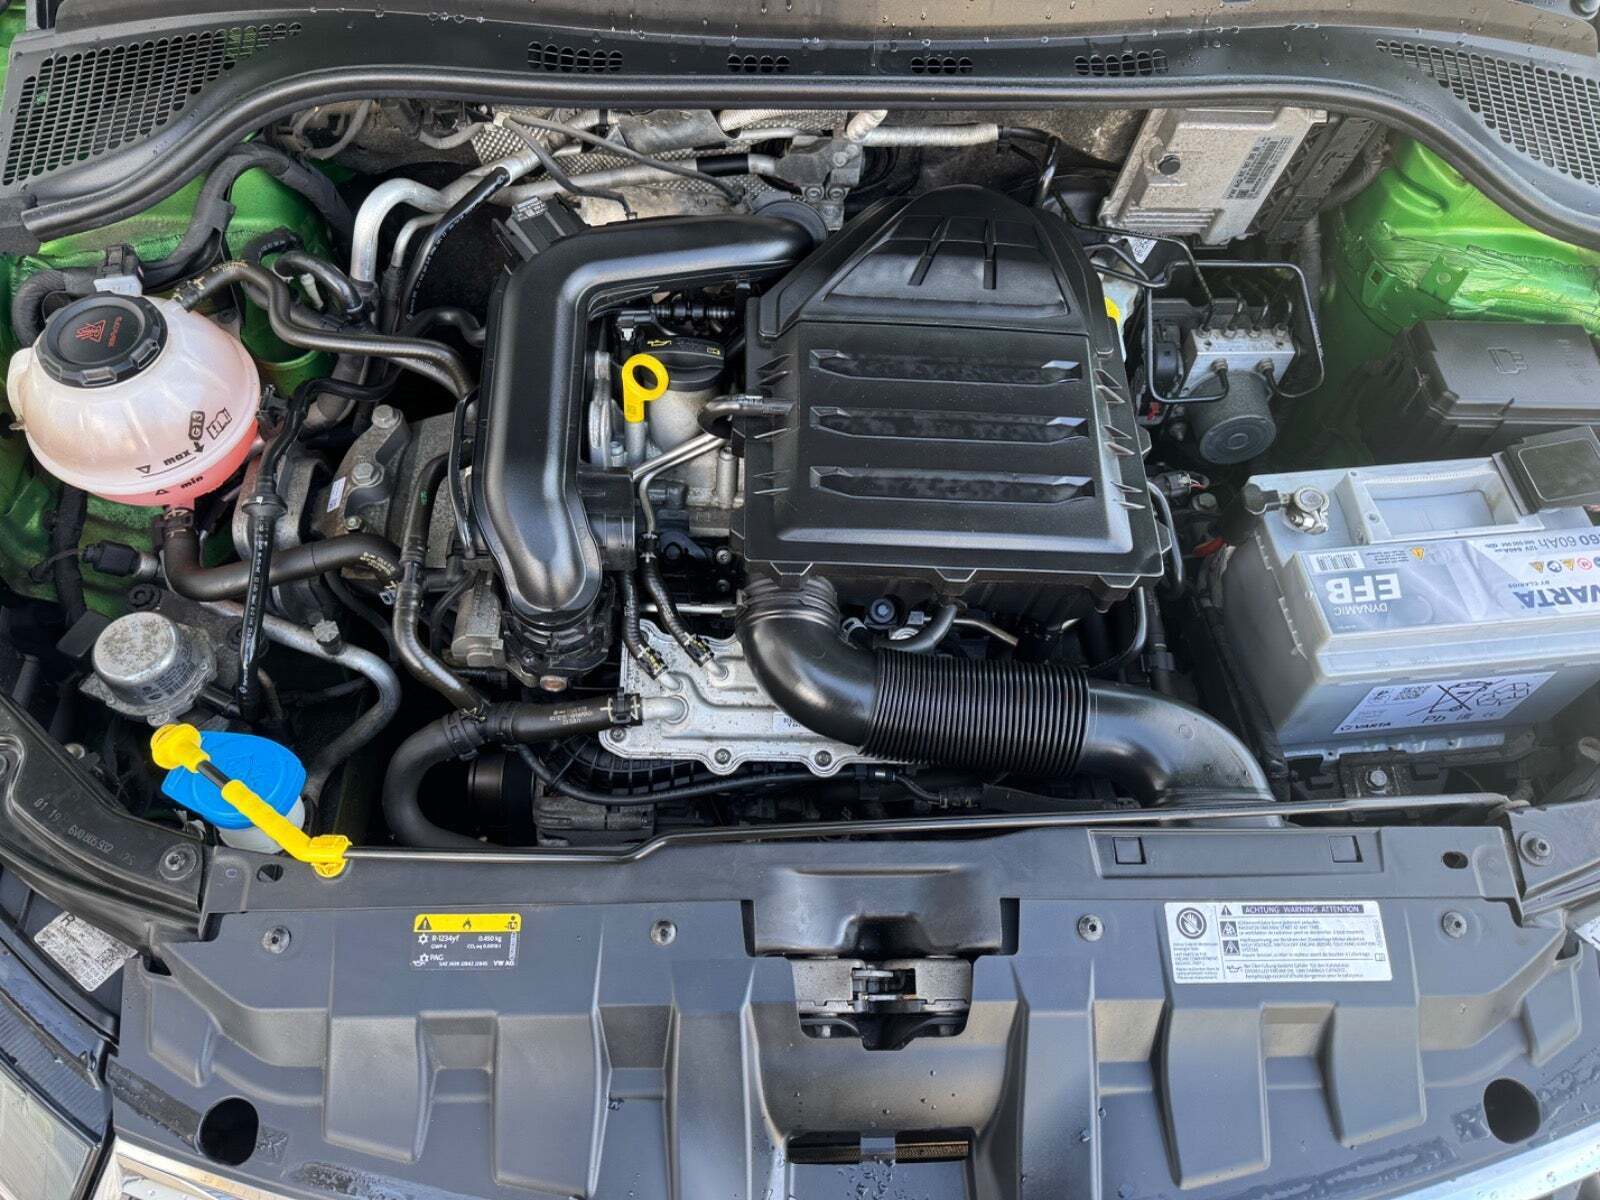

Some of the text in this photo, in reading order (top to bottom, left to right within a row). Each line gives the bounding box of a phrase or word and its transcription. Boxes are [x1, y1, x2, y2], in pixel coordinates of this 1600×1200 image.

[163, 449, 191, 466] max
[181, 475, 204, 489] min
[1538, 536, 1577, 549] 60Ah
[1325, 573, 1402, 605] EFB
[1334, 602, 1388, 617] DYNAMIC
[1245, 905, 1360, 914] ACHTUNG WARNING ATTENTION
